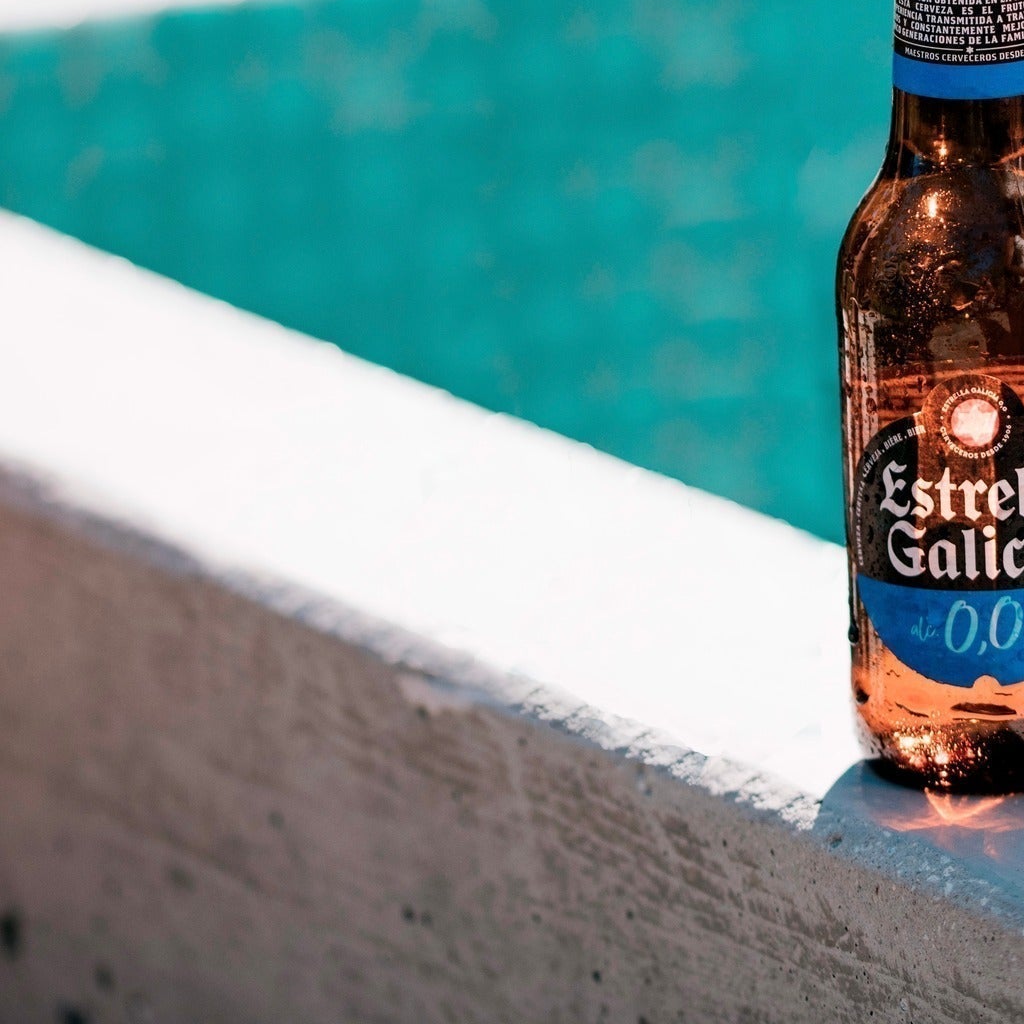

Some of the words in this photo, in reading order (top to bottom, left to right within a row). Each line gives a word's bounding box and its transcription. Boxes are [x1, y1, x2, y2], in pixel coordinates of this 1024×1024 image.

[896, 4, 923, 22] PERIENCIA
[926, 14, 993, 25] TRANSMITIDA
[996, 14, 1004, 23] A
[916, 2, 953, 14] CERVEZA
[962, 6, 974, 15] ES
[982, 6, 994, 14] EL
[903, 18, 908, 26] Y
[910, 21, 996, 34] CONSTANTEMENTE
[902, 28, 965, 44] GENERACIONES
[968, 36, 982, 44] DE
[985, 35, 998, 44] LA
[904, 46, 940, 60] MAESTROS
[942, 53, 997, 62] CERVECEROS
[1000, 48, 1024, 60] DESDE
[942, 388, 970, 412] ESTRELLA
[970, 386, 999, 402] GALICIA
[907, 424, 926, 437] BIER
[940, 426, 978, 458] CERVECEROS
[980, 442, 1003, 458] DESDE
[1002, 424, 1012, 442] 1906
[944, 596, 1024, 656] 0,0
